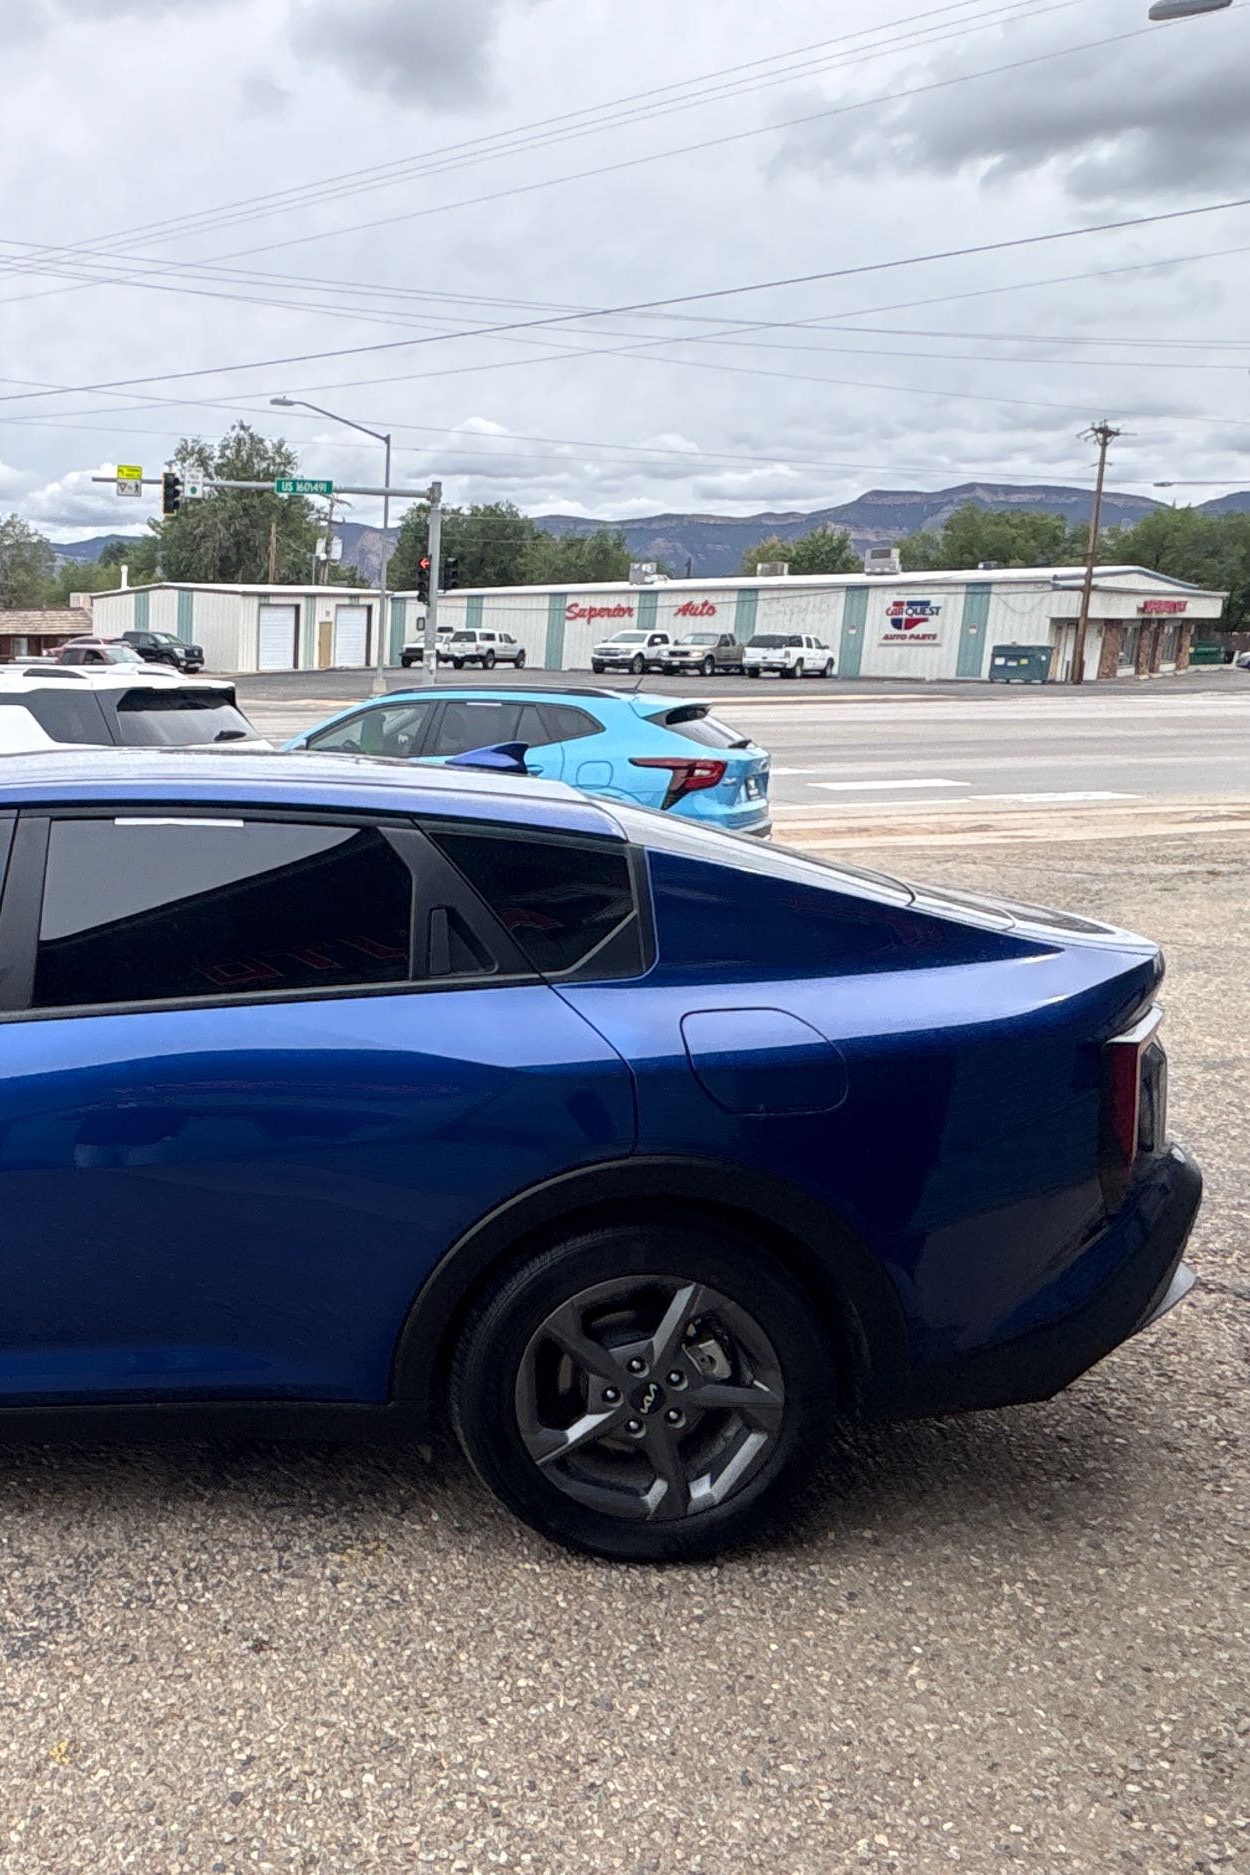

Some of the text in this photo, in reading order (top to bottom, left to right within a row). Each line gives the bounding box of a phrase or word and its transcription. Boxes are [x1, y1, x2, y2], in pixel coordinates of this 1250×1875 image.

[281, 481, 294, 492] US
[565, 600, 717, 625] Superior Auto
